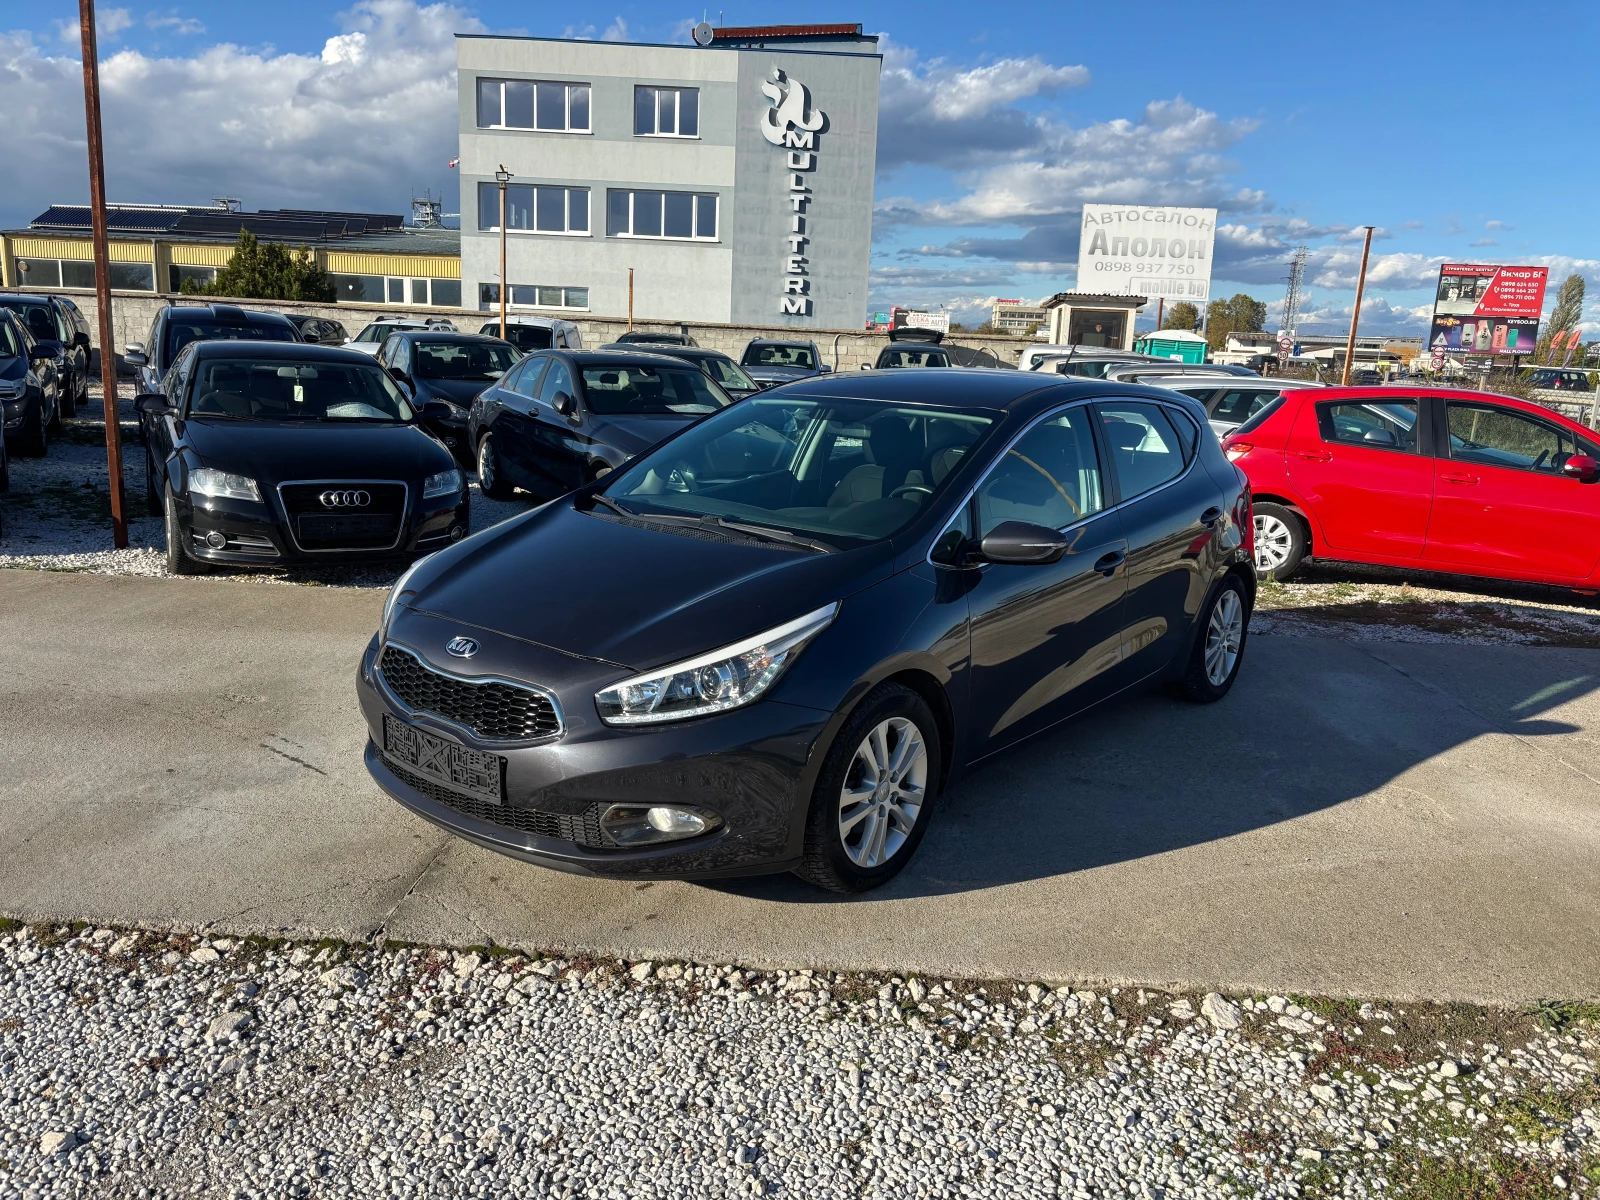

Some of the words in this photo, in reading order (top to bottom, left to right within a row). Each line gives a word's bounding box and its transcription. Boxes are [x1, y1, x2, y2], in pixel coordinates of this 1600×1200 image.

[780, 130, 814, 314] MULTITERM
[1083, 209, 1215, 232] Автосалон
[1087, 228, 1207, 260] Аполон
[1094, 261, 1132, 272] 0898
[1136, 262, 1164, 274] 937
[1168, 263, 1195, 275] 750
[1500, 270, 1531, 280] Вимар
